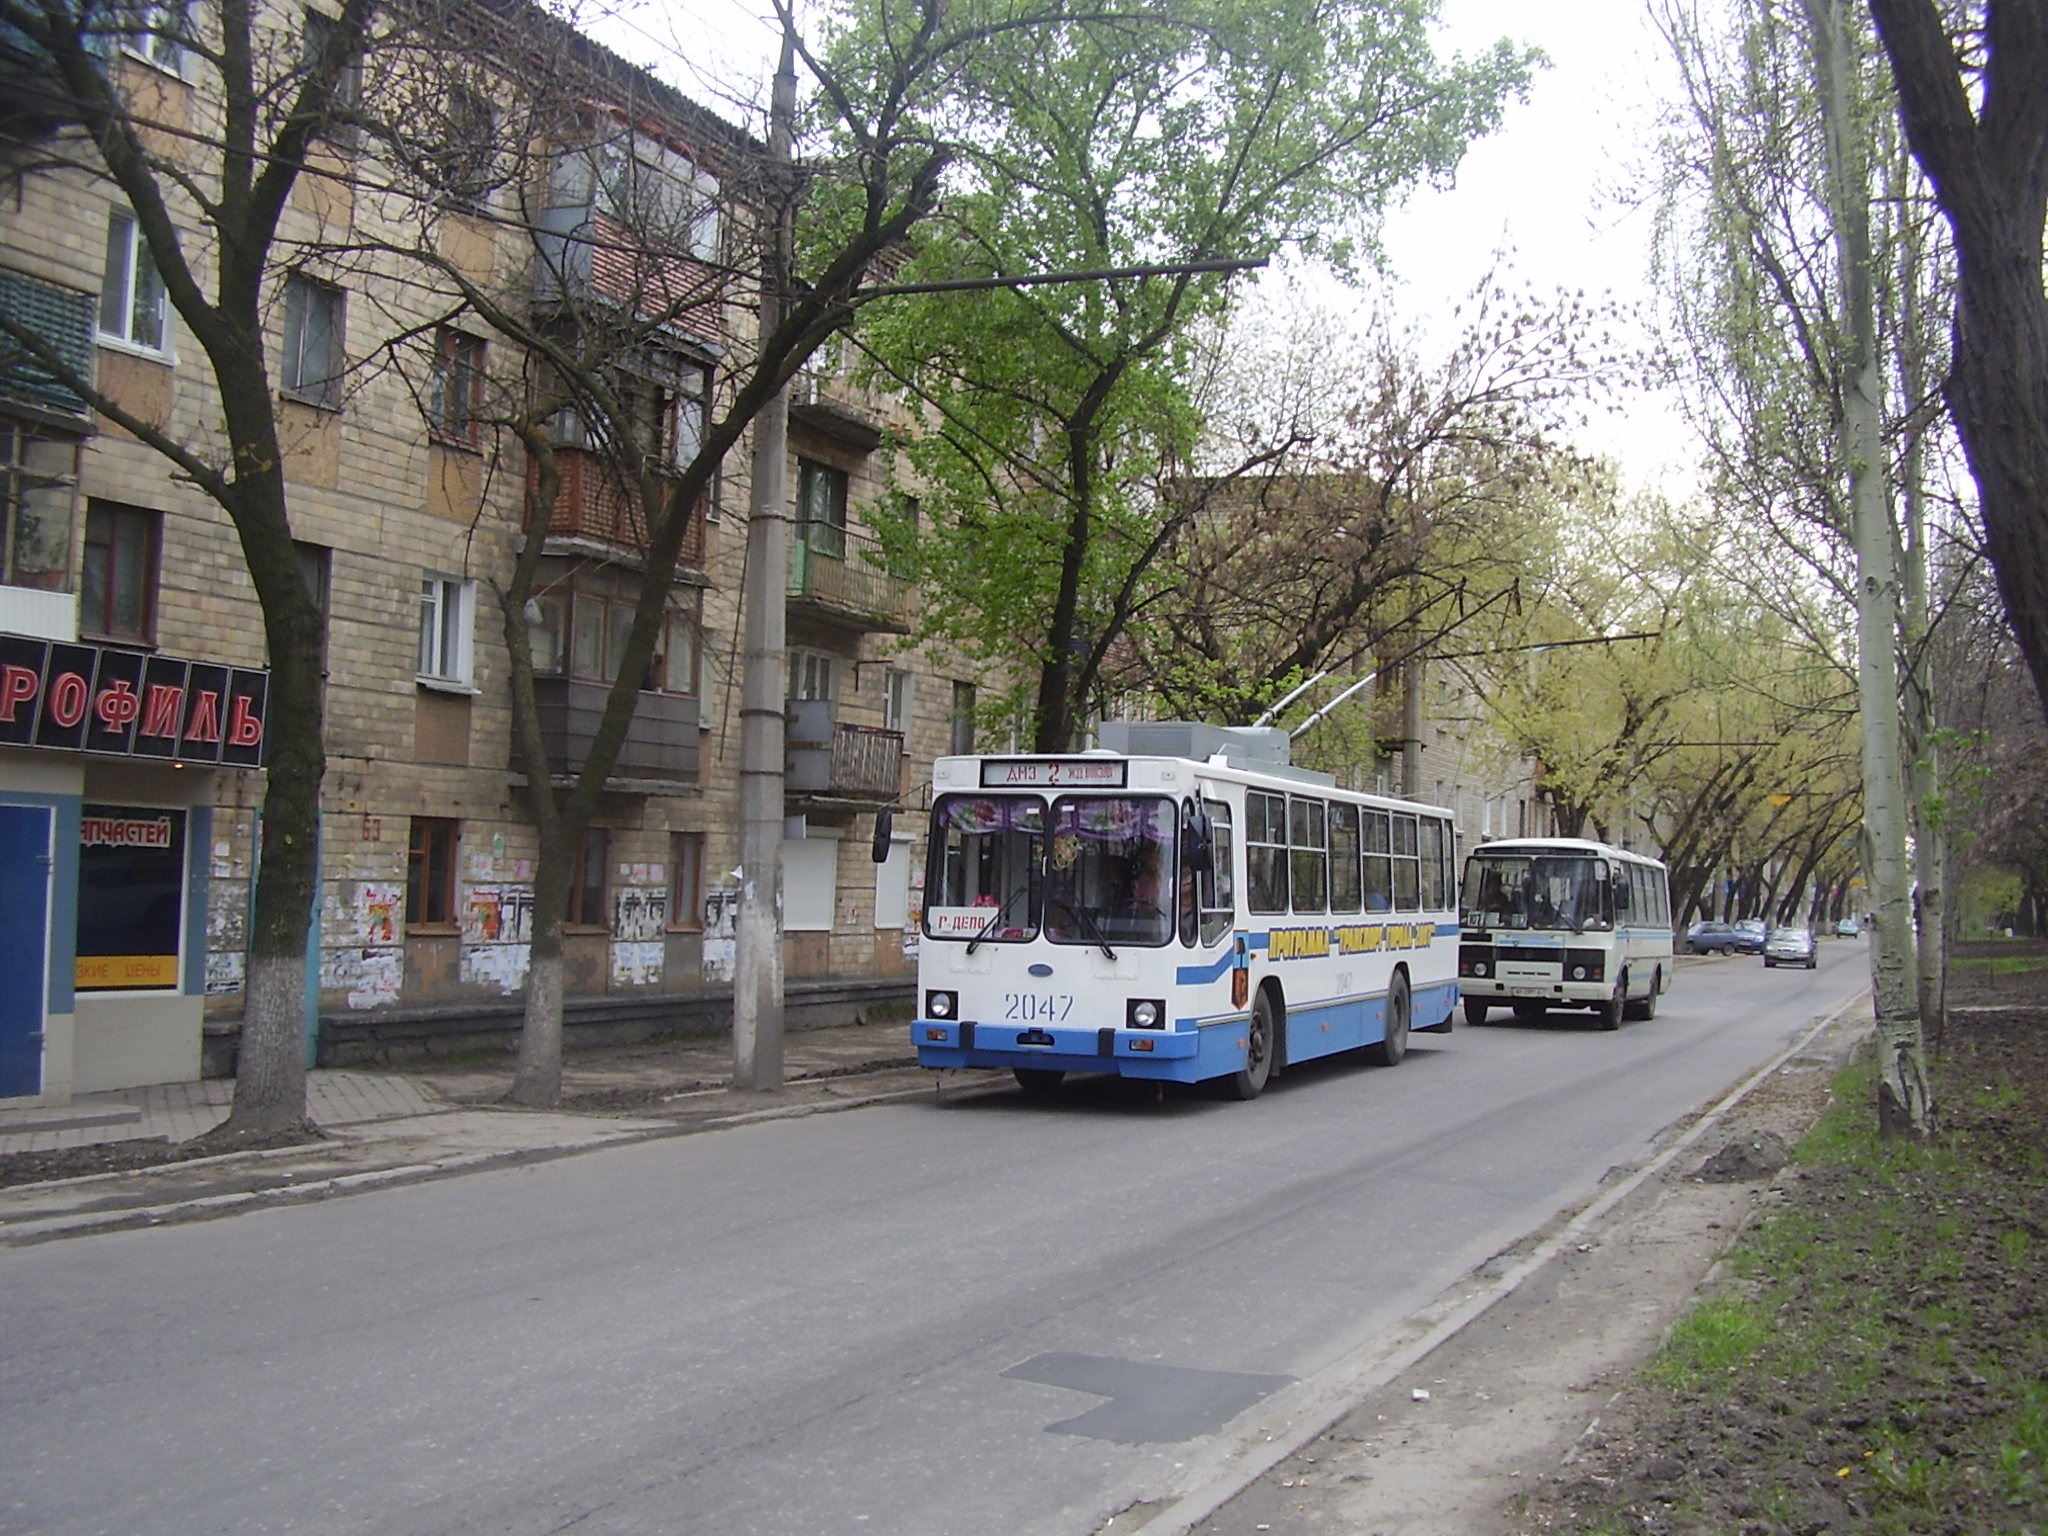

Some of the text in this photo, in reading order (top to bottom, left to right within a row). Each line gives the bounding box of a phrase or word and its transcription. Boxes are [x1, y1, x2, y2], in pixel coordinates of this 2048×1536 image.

[1048, 763, 1060, 783] 2
[125, 962, 161, 979] ЦЕНЫ
[1004, 993, 1074, 1022] 2047
